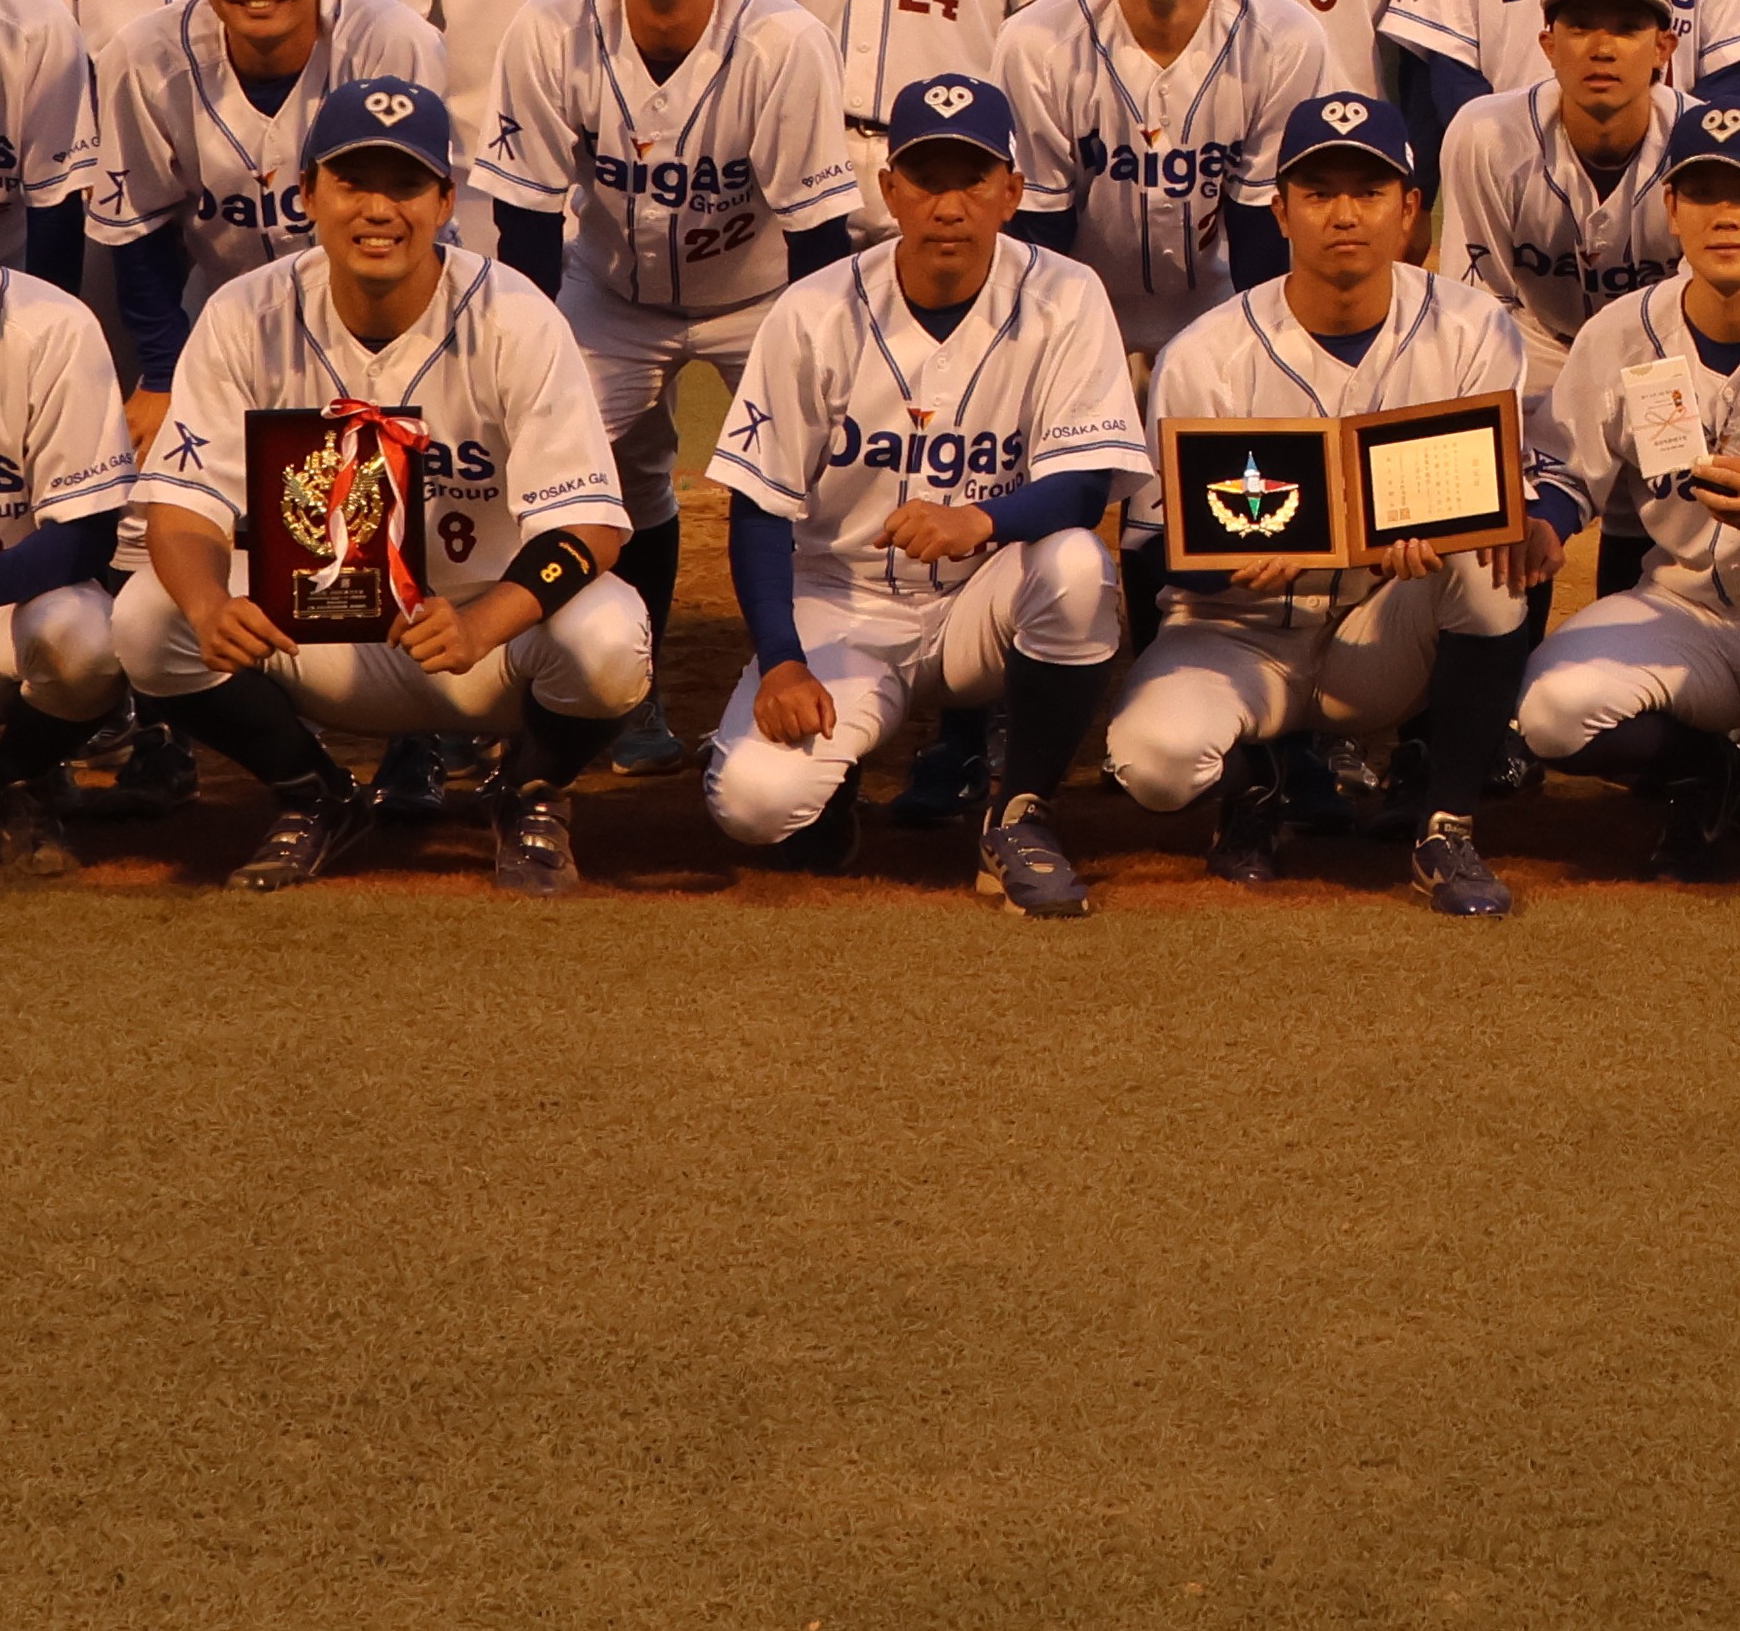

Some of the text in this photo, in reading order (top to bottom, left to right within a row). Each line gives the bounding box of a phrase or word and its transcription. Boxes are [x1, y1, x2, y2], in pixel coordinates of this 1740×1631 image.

[685, 212, 756, 263] 22
[1052, 419, 1127, 440] OSAKA GAS
[63, 463, 109, 486] OSAKA
[540, 478, 585, 501] OSAKA
[438, 511, 477, 563] 8
[540, 562, 563, 583] 8
